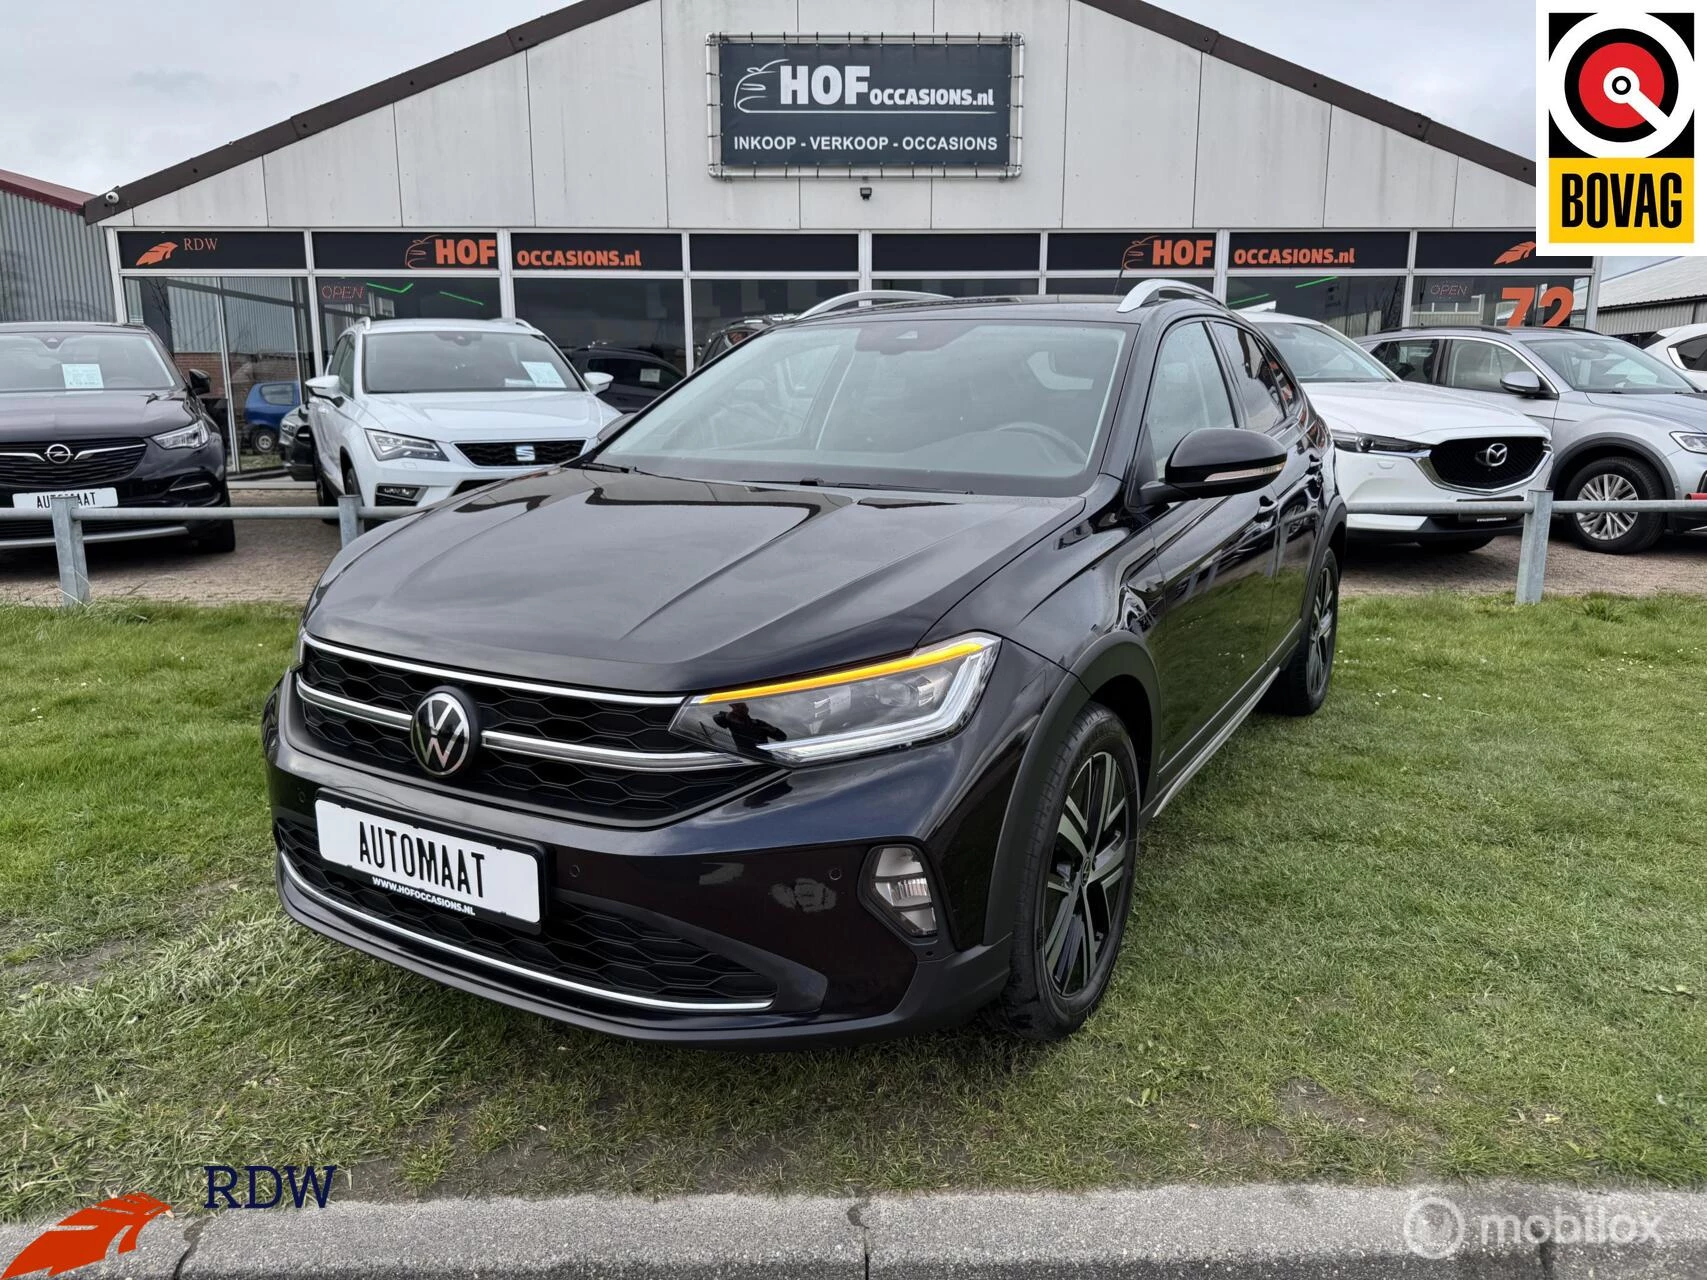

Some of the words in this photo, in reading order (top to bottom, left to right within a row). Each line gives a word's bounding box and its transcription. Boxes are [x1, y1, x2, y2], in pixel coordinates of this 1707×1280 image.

[780, 65, 870, 105] HOF
[869, 88, 994, 106] OCCASIONS.nl
[734, 136, 796, 151] INKOOP
[810, 136, 889, 151] VERKOOP
[902, 136, 998, 151] OCCASIONS
[183, 238, 218, 251] RDW
[435, 239, 496, 265] HOF
[516, 250, 642, 267] OCCASIONS.nl
[1152, 239, 1213, 266] HOF
[1233, 248, 1356, 265] OCCASIONS.nl
[321, 285, 364, 299] OPEN
[1430, 284, 1468, 296] OPEN
[1502, 286, 1575, 328] 72
[37, 492, 96, 509] AUAAT
[359, 821, 485, 898] AUTOMAAT
[371, 876, 476, 916] WWW.HOFOCCASIONS.NL
